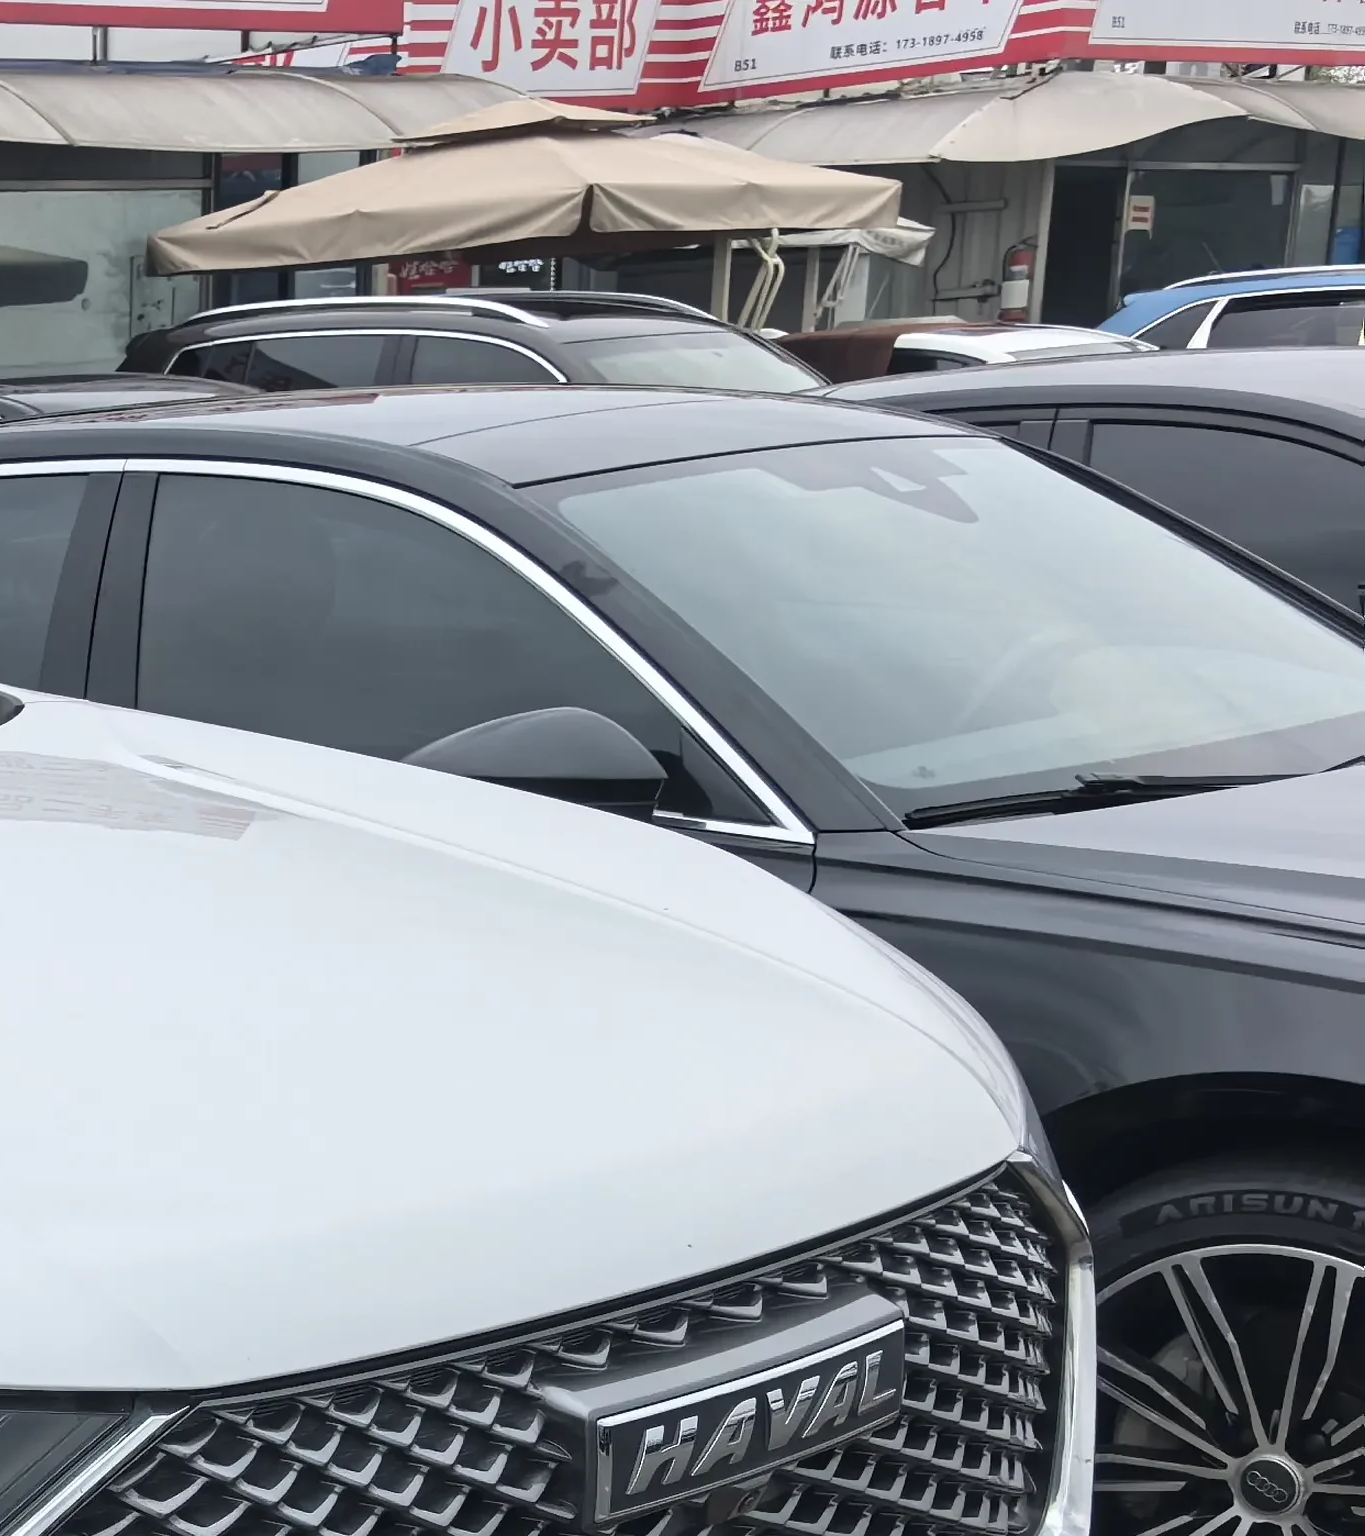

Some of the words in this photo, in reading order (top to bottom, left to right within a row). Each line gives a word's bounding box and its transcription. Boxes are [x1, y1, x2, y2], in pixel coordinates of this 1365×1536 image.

[470, 0, 638, 72] 小卖部
[734, 58, 757, 72] B51
[1155, 1193, 1340, 1226] ARISUN
[625, 1350, 896, 1495] HAVAL
